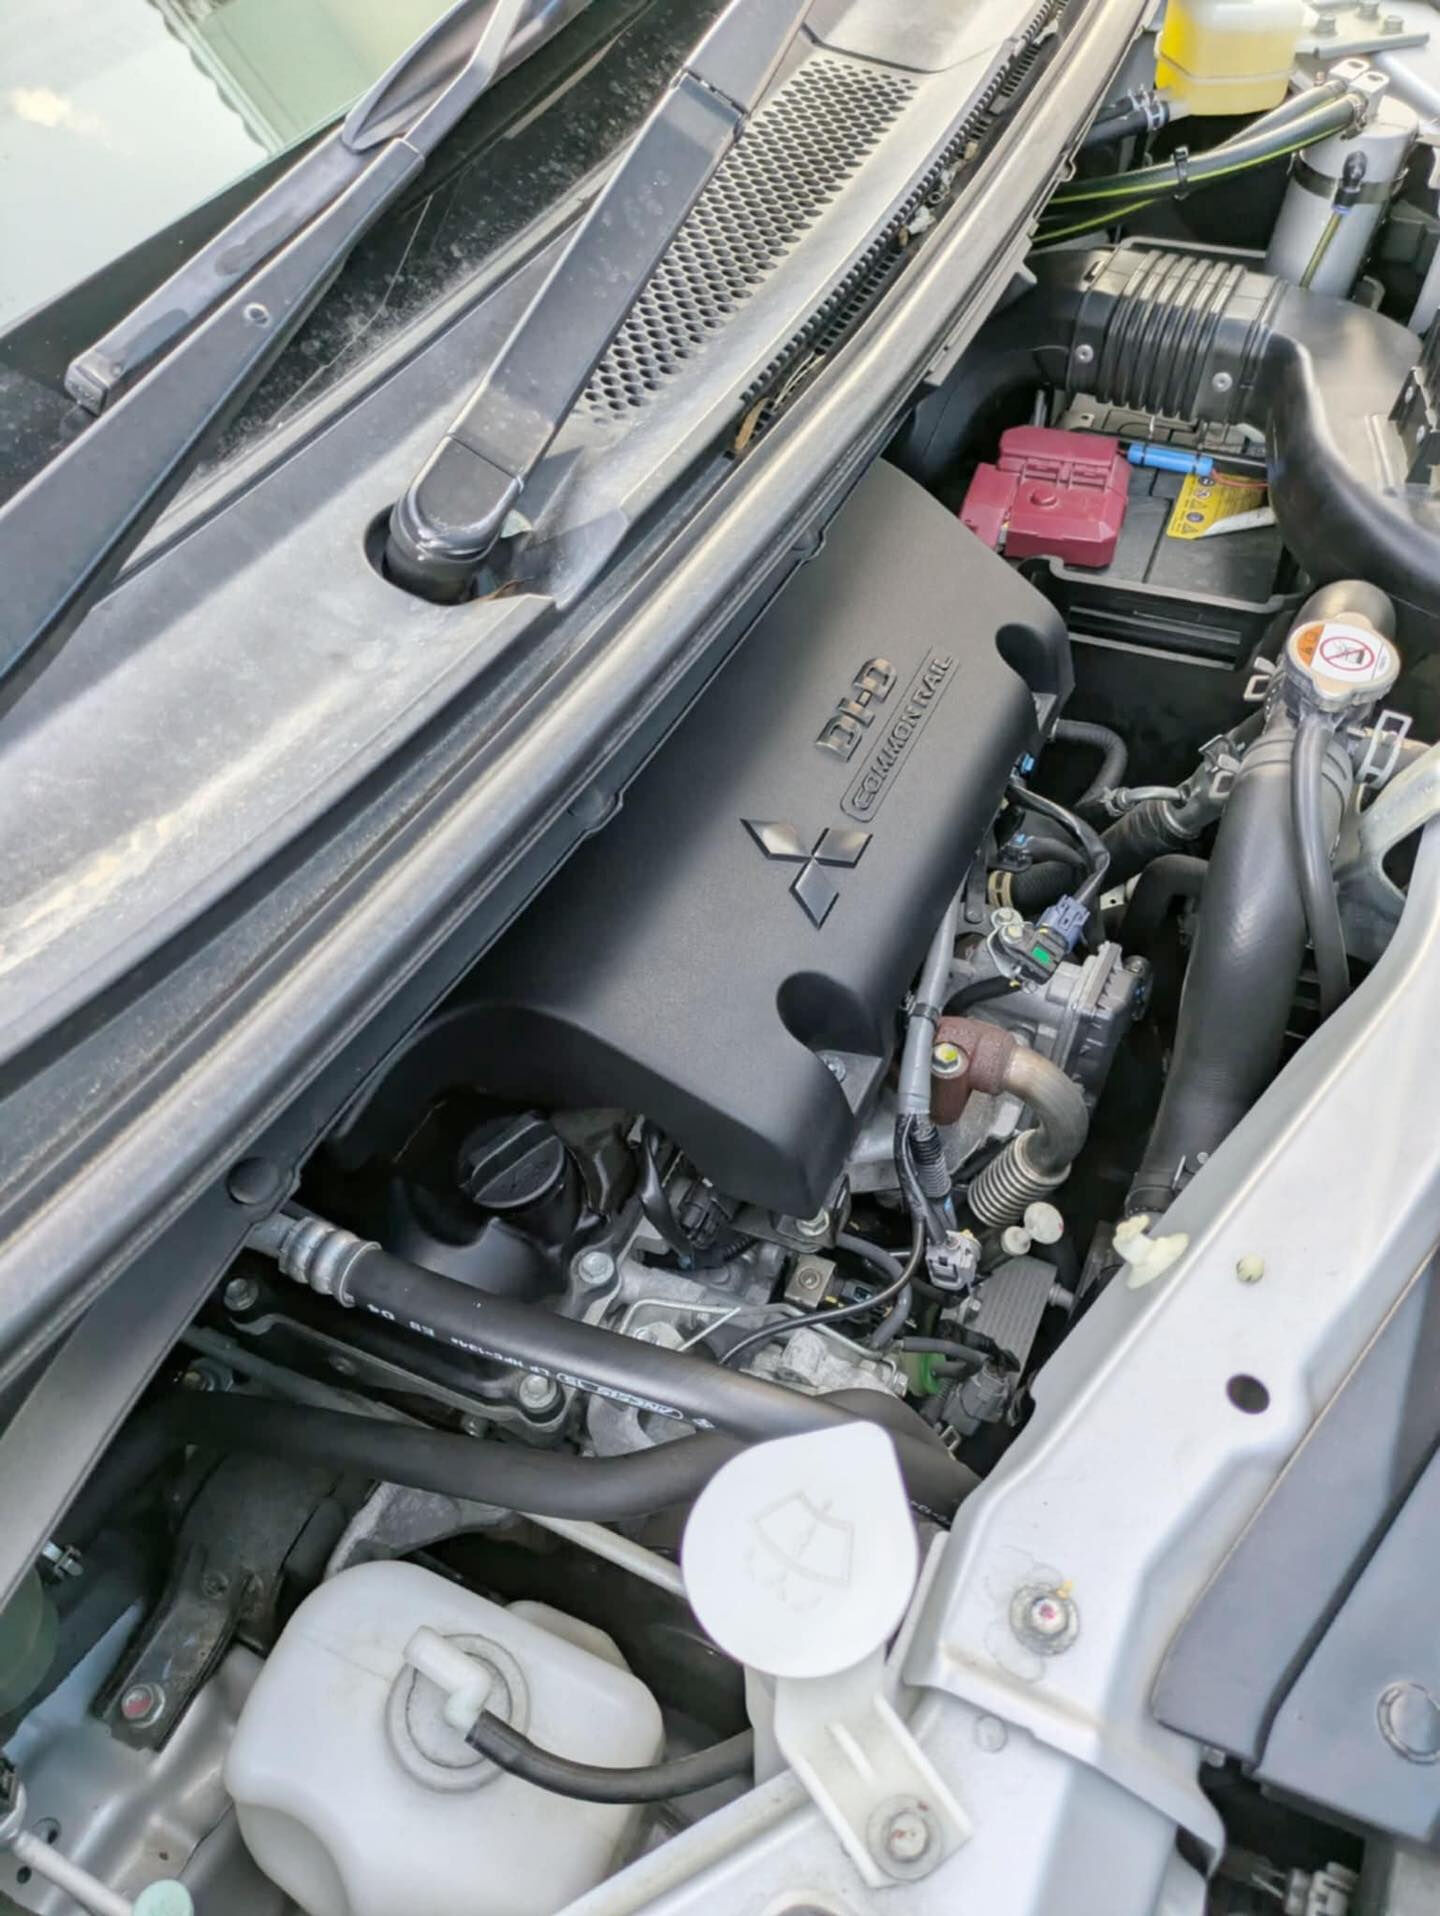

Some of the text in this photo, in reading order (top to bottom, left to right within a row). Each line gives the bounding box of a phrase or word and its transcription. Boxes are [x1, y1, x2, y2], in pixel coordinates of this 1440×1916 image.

[815, 658, 898, 763] DI-D
[852, 655, 954, 811] COMMON RAIL
